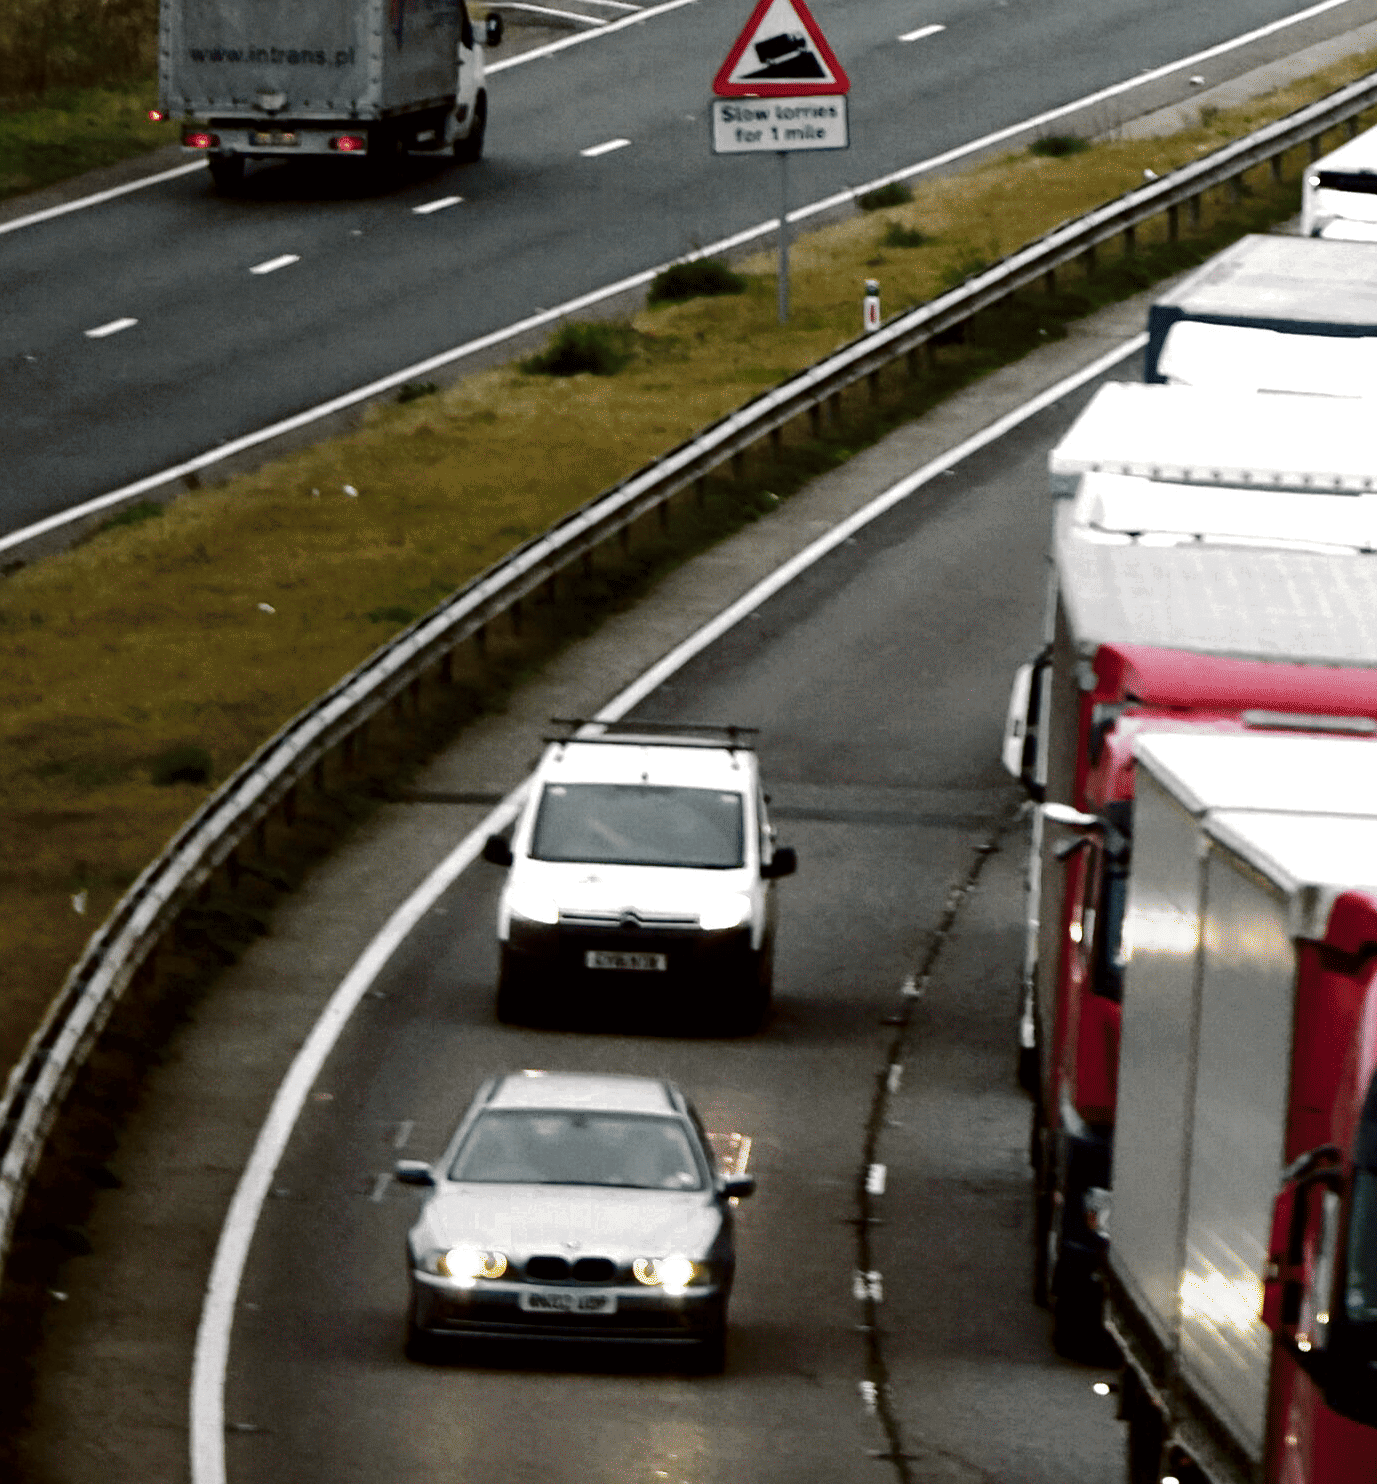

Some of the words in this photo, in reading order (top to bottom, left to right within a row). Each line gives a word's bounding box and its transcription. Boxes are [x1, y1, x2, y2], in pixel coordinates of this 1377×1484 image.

[721, 104, 770, 123] Slow
[774, 104, 838, 121] lorries
[735, 126, 763, 143] for
[771, 125, 779, 141] 1
[784, 124, 826, 140] mile
